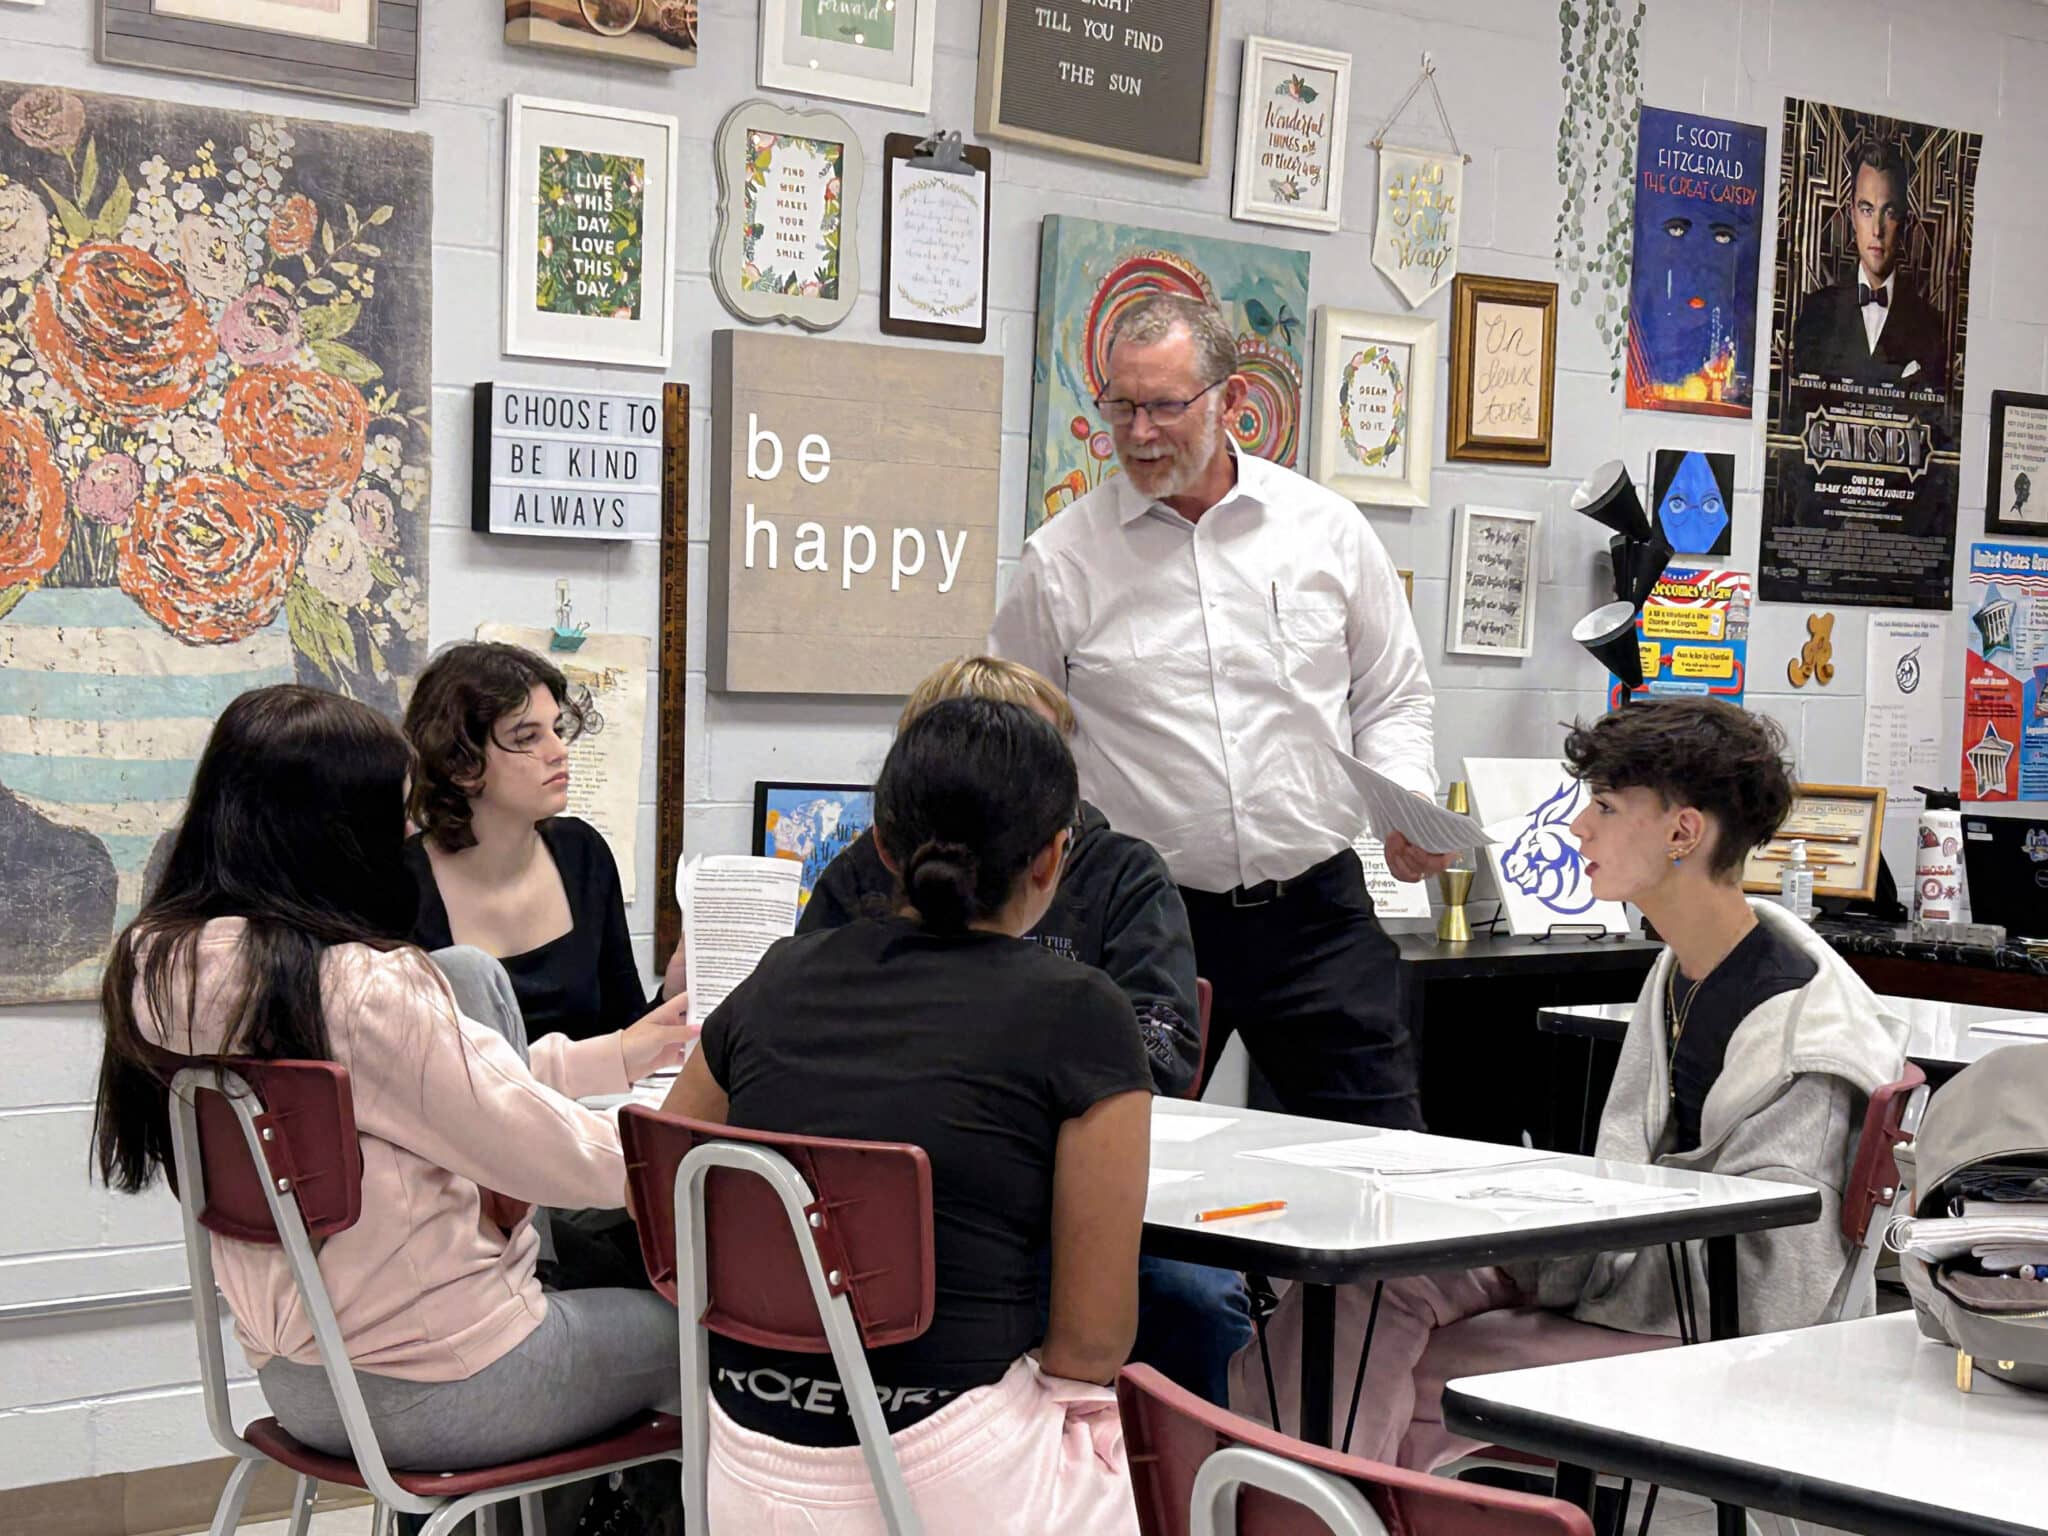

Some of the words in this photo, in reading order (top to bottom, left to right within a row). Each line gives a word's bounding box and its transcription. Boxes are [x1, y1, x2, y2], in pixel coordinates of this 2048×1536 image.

[1035, 8, 1072, 33] TILL
[1083, 18, 1114, 42] YOU
[1124, 28, 1163, 53] FIND
[1058, 61, 1095, 86] THE
[1109, 73, 1142, 96] SUN
[1690, 127, 1732, 152] SCOTT
[783, 167, 804, 178] FIND
[1658, 148, 1743, 180] FITZGERALD
[576, 172, 613, 191] LIVE
[780, 183, 806, 195] WHAT
[1643, 171, 1666, 194] THE
[574, 194, 613, 212] THIS
[777, 200, 808, 211] MAKES
[577, 215, 611, 233] DAY.
[779, 216, 804, 227] YOUR
[572, 236, 614, 256] LOVE
[776, 232, 807, 244] HEART
[573, 258, 612, 276] THIS
[576, 279, 611, 298] DAY.
[1359, 385, 1387, 397] DREAM
[505, 394, 610, 431] CHOOSE
[627, 403, 657, 434] TO
[1369, 405, 1386, 414] AND
[1360, 422, 1371, 432] DO
[746, 413, 831, 484] be
[1809, 420, 1925, 466] GATSBY
[511, 444, 543, 475] BE
[569, 447, 637, 480] KIND
[514, 493, 625, 528] ALWAYS
[744, 503, 968, 593] happy
[2003, 551, 2031, 570] States
